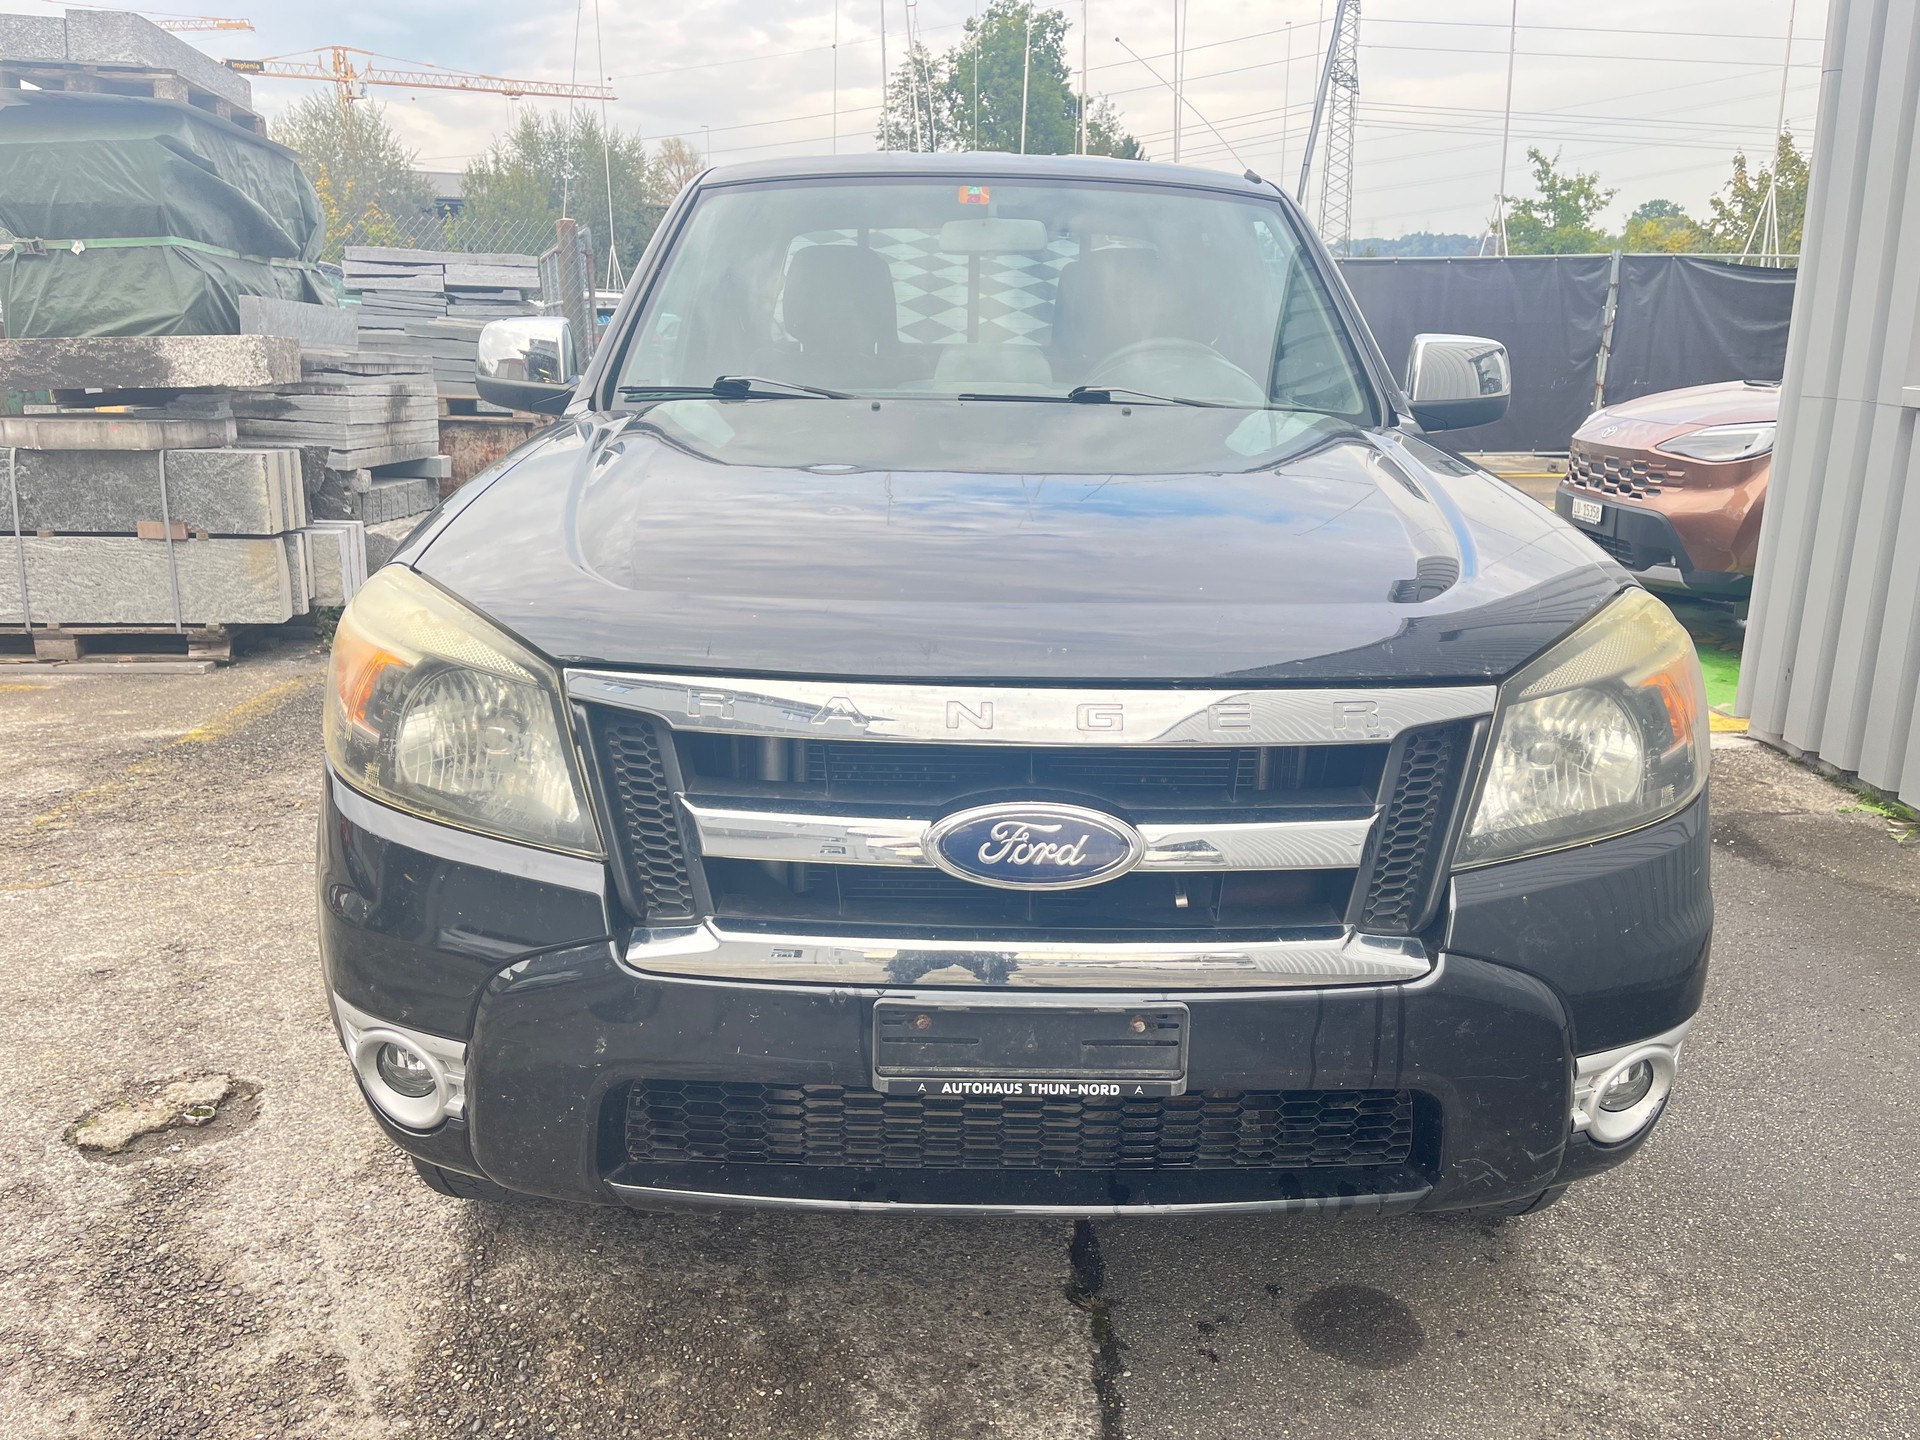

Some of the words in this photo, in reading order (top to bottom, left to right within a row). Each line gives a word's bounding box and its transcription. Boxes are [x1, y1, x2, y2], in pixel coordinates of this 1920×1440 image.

[231, 62, 260, 70] Implenia
[686, 687, 1381, 733] RANGER
[977, 820, 1090, 867] Ford
[941, 1082, 1023, 1095] AUTOHAUS
[1028, 1083, 1120, 1096] THUN-NORD
